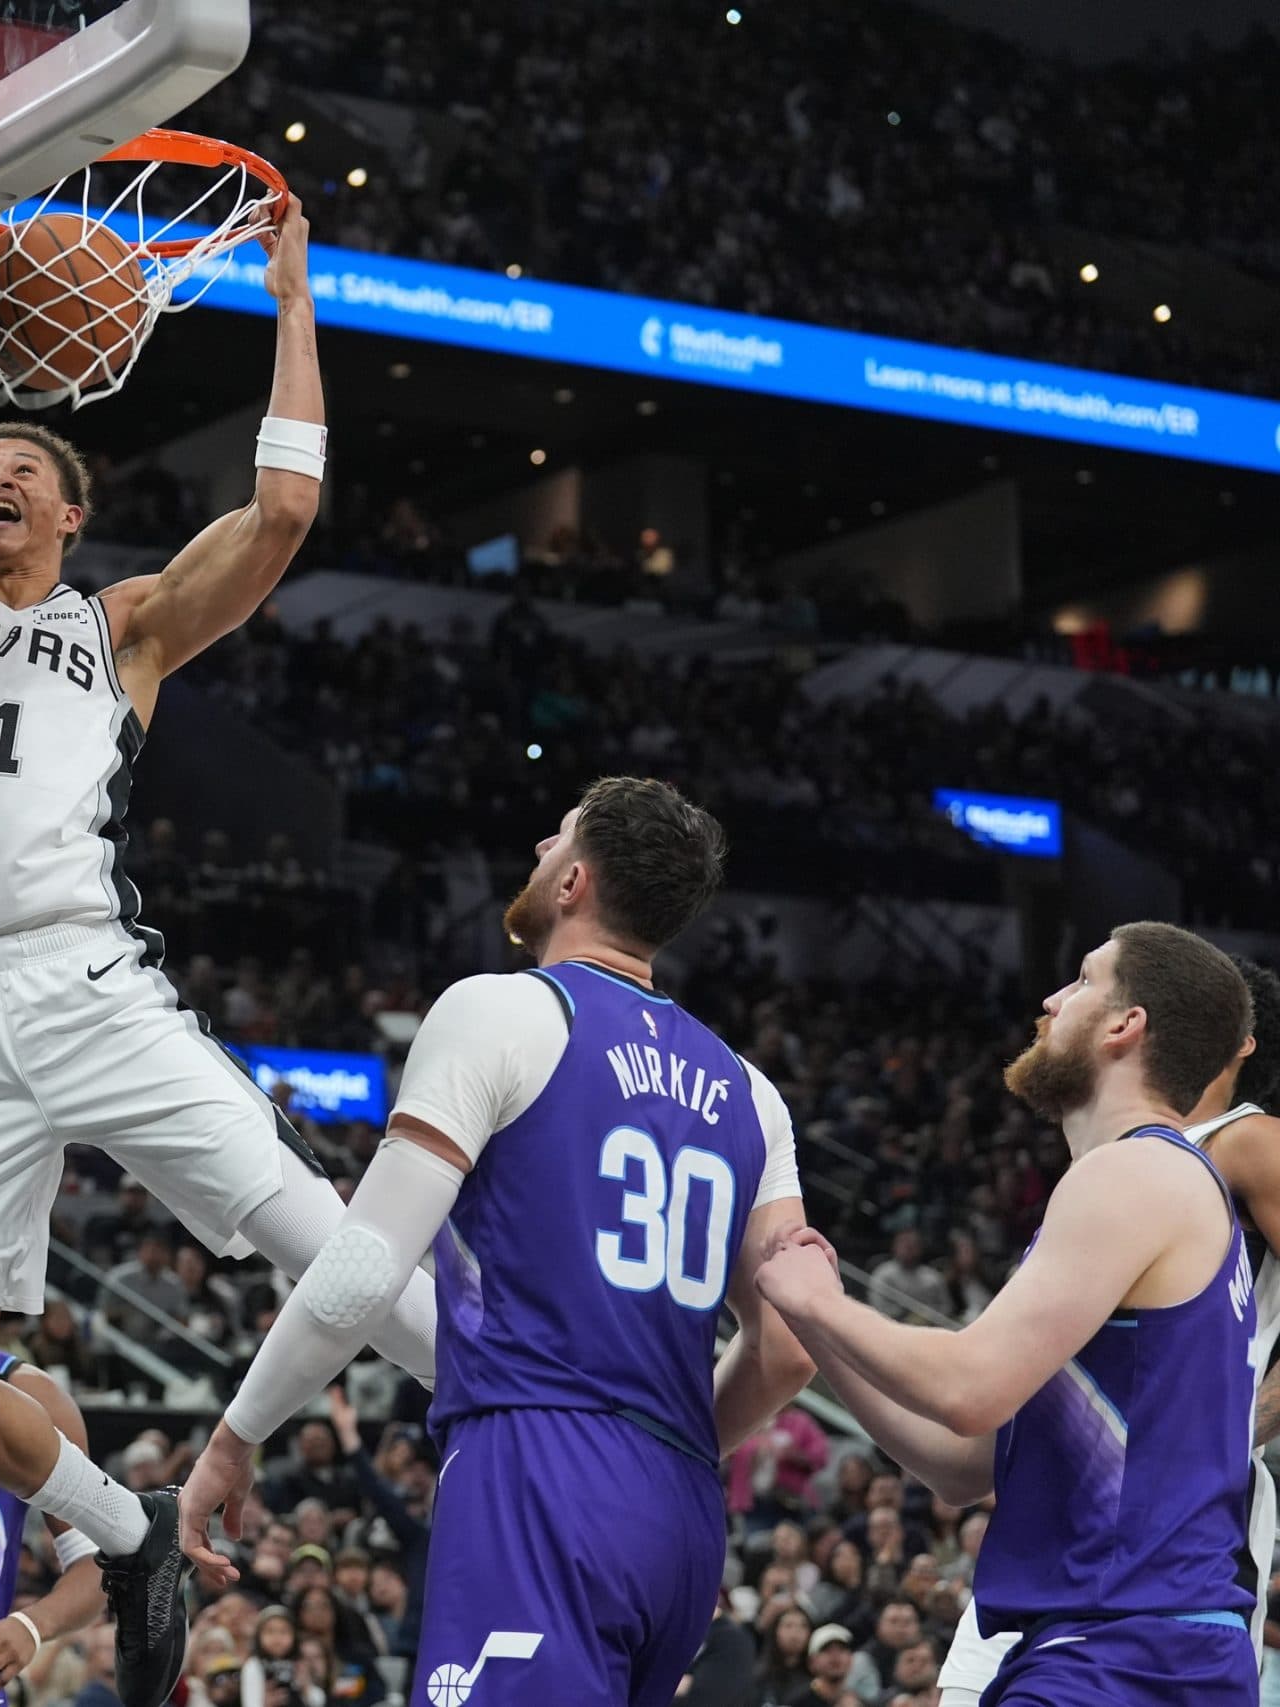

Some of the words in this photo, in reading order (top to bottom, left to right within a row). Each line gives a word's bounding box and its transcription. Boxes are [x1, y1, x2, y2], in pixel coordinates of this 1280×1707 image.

[864, 357, 927, 392] Learn
[929, 373, 986, 403] more
[989, 381, 1012, 408] at
[39, 612, 81, 622] LEDGER
[606, 1042, 731, 1125] NURKIĆ
[596, 1125, 735, 1311] 30
